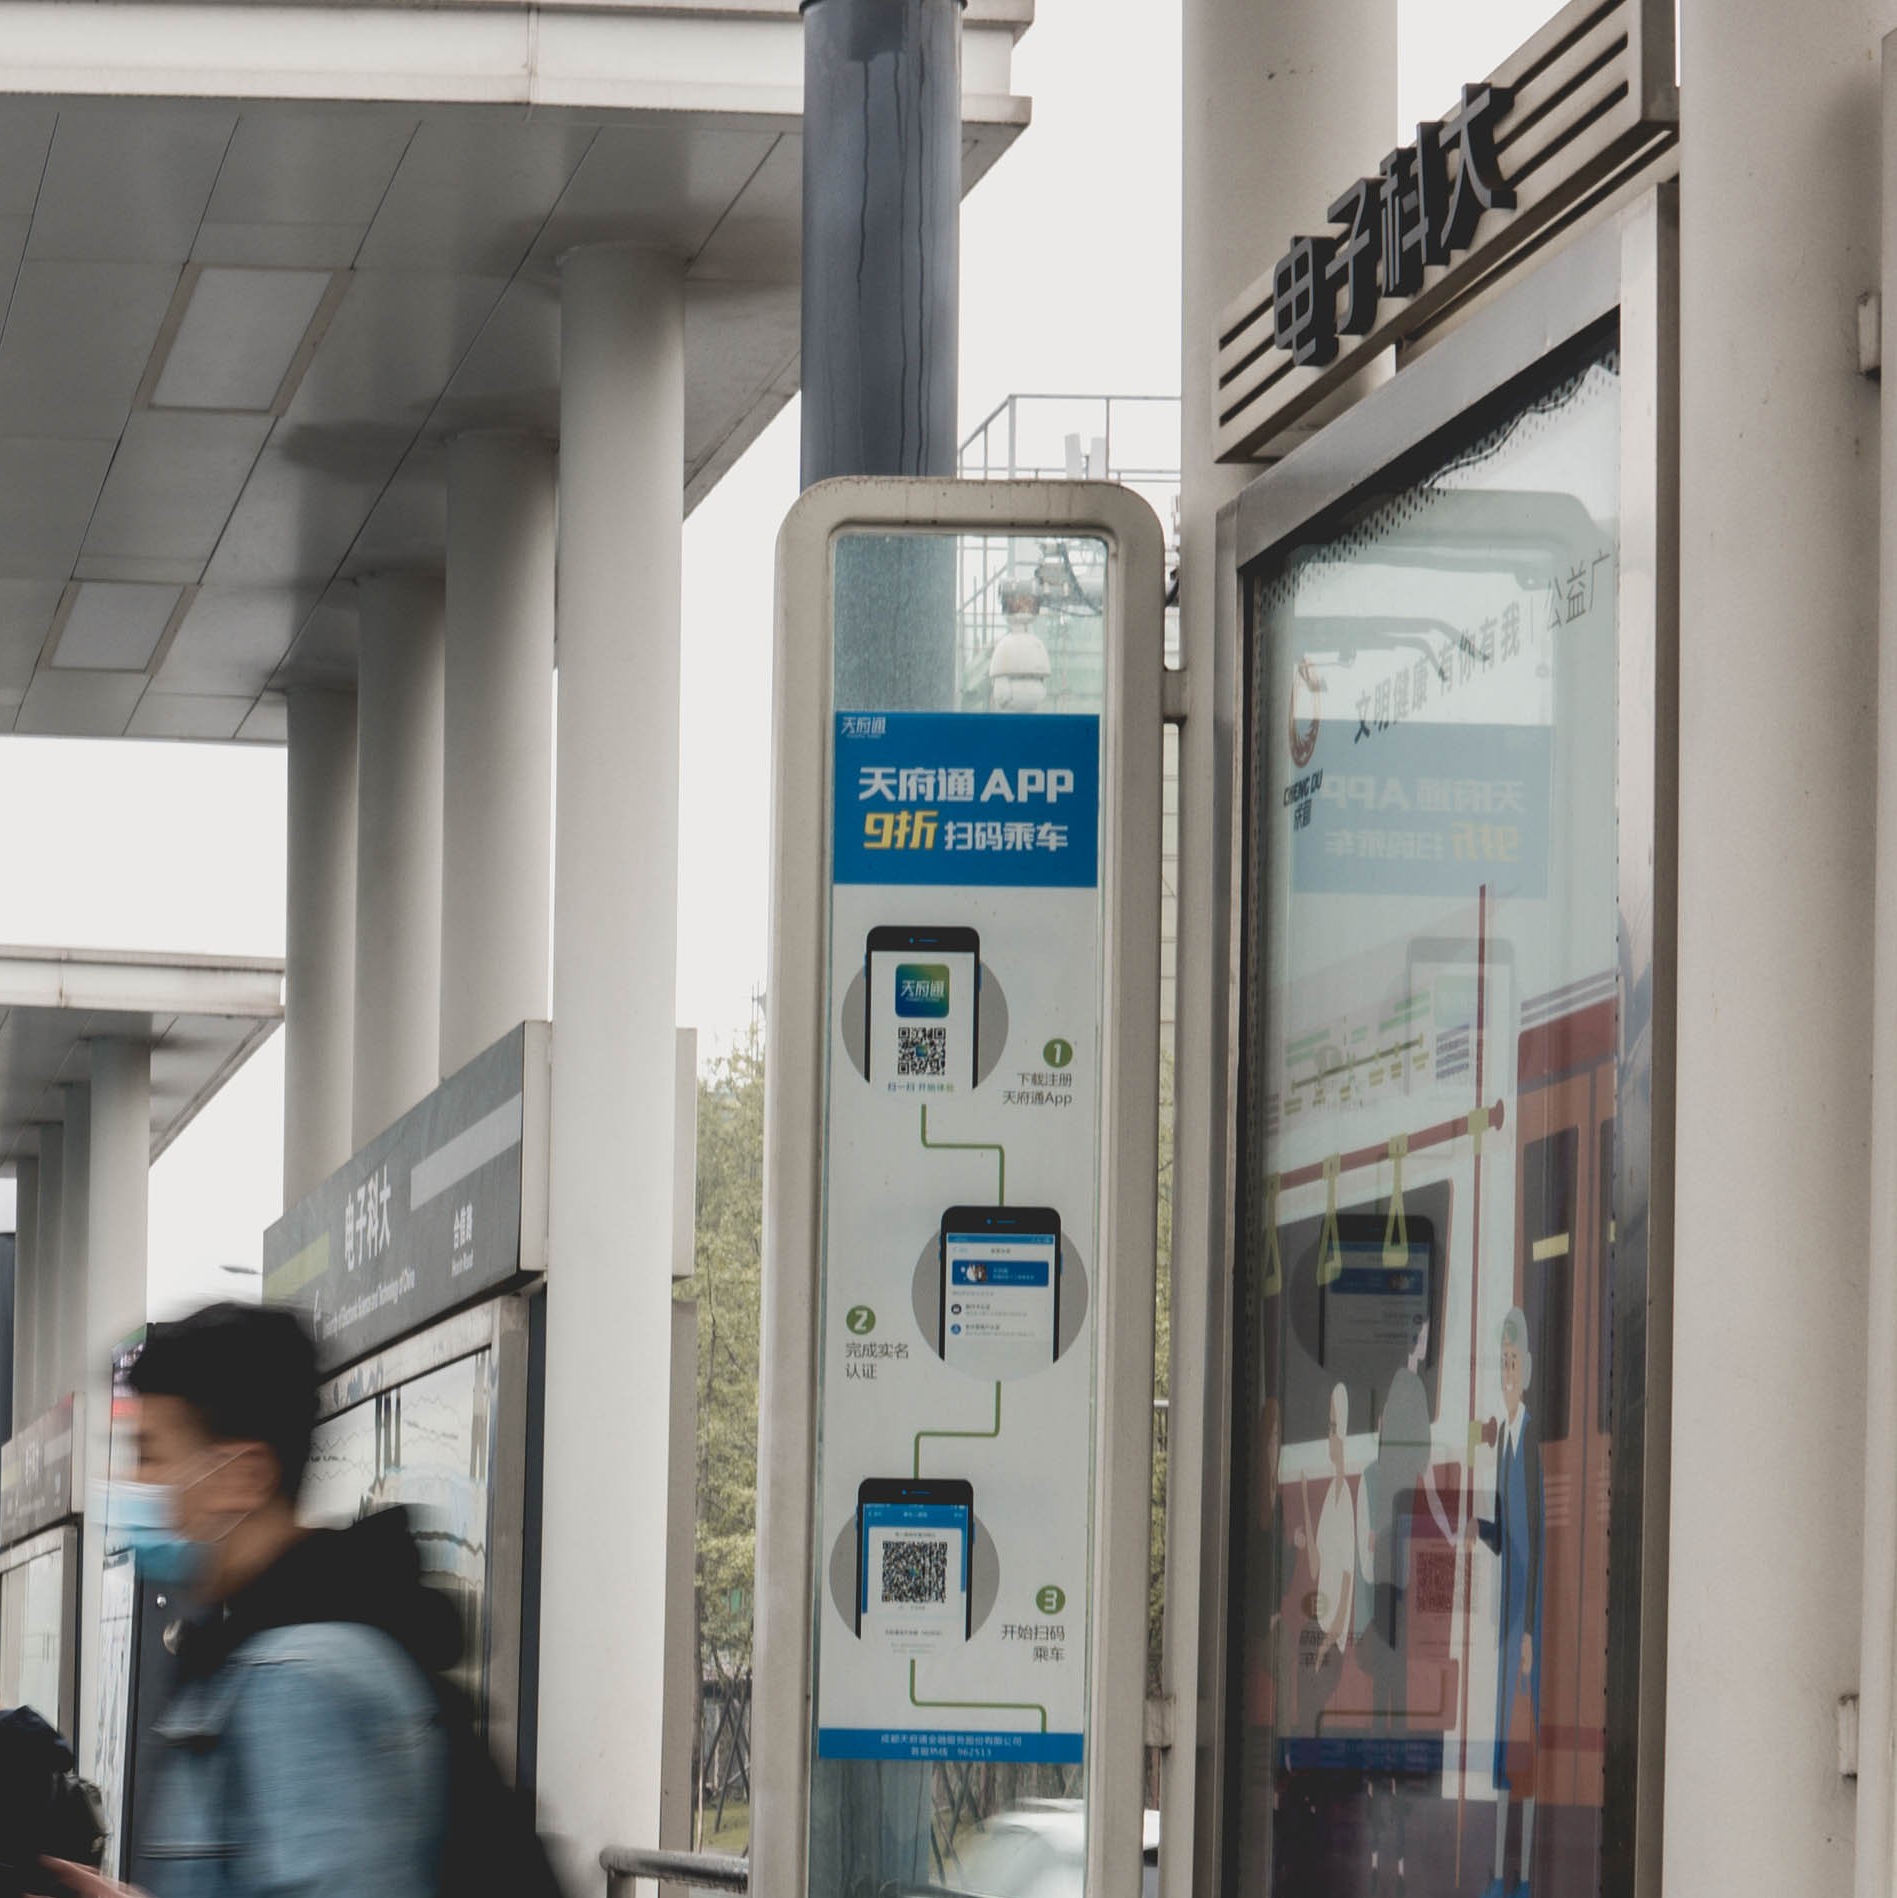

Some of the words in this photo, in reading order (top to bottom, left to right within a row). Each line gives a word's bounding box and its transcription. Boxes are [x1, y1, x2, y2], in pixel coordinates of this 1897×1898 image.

[1274, 83, 1505, 366] 电子科大
[842, 717, 886, 735] 天府通
[864, 810, 939, 851] 9折
[944, 821, 1069, 852] 扫码乘车
[900, 979, 946, 998] 天府通
[1017, 1072, 1072, 1087] 下载注册
[345, 1163, 392, 1273] 电子科大
[845, 1343, 909, 1360] 完成实名
[845, 1363, 877, 1380] 认证
[1001, 1624, 1066, 1641] 开始扫码
[1033, 1646, 1066, 1662] 乘车
